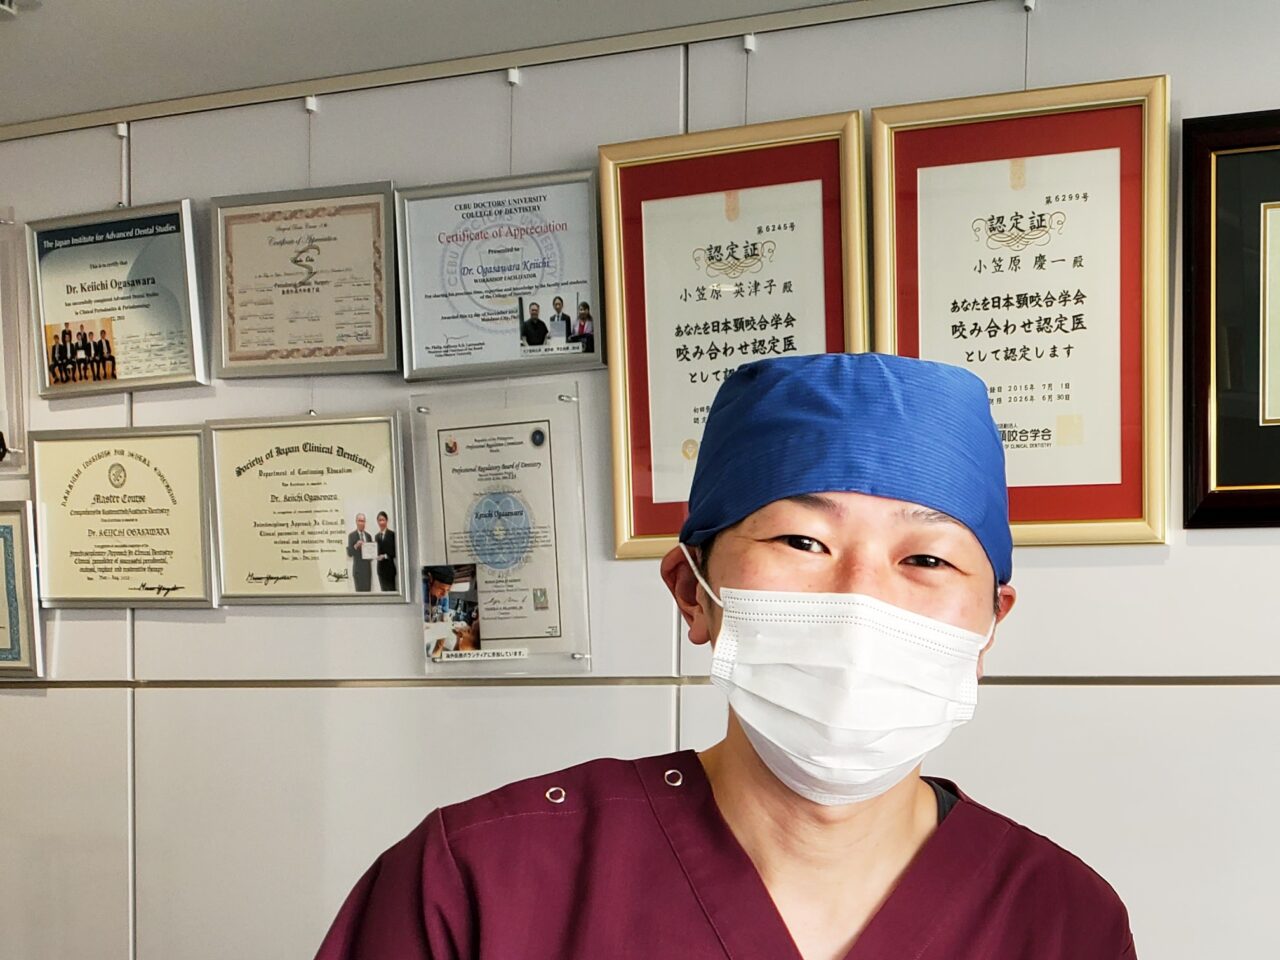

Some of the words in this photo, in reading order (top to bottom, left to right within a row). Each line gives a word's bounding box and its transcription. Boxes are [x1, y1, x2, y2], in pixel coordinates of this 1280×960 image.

[454, 202, 472, 211] CEBU
[508, 194, 548, 207] UNIVERSITY
[1045, 192, 1090, 205] 第6299号
[461, 210, 492, 220] COLLEGE
[494, 208, 504, 216] OF
[504, 204, 541, 216] DENTISTRY
[988, 211, 1047, 233] 認定証
[44, 240, 53, 248] The
[54, 239, 70, 248] Japan
[72, 236, 94, 245] Institute
[106, 228, 133, 240] Advanced
[135, 225, 154, 236] Dental
[155, 222, 176, 233] Studies
[438, 229, 490, 244] Certificate
[492, 226, 504, 239] of
[505, 221, 568, 240] Appreciation
[706, 240, 760, 262] 認定証
[476, 263, 521, 276] Ogasawara
[973, 256, 1022, 274] 小笠原
[66, 284, 78, 294] Dr.
[80, 280, 108, 293] Keiichi
[111, 276, 156, 290] Ogasawara
[950, 288, 1088, 313] あなたを日本顎咬合学会
[674, 312, 797, 338] あなたを日本顎咬合学会
[951, 313, 1088, 340] 咬み合わせ認定医
[676, 335, 797, 362] 咬み合わせ認定医
[965, 344, 1075, 362] として認定します
[234, 456, 264, 478] Society
[265, 450, 274, 461] of
[302, 442, 333, 455] Clinical
[336, 446, 375, 474] Dentistry
